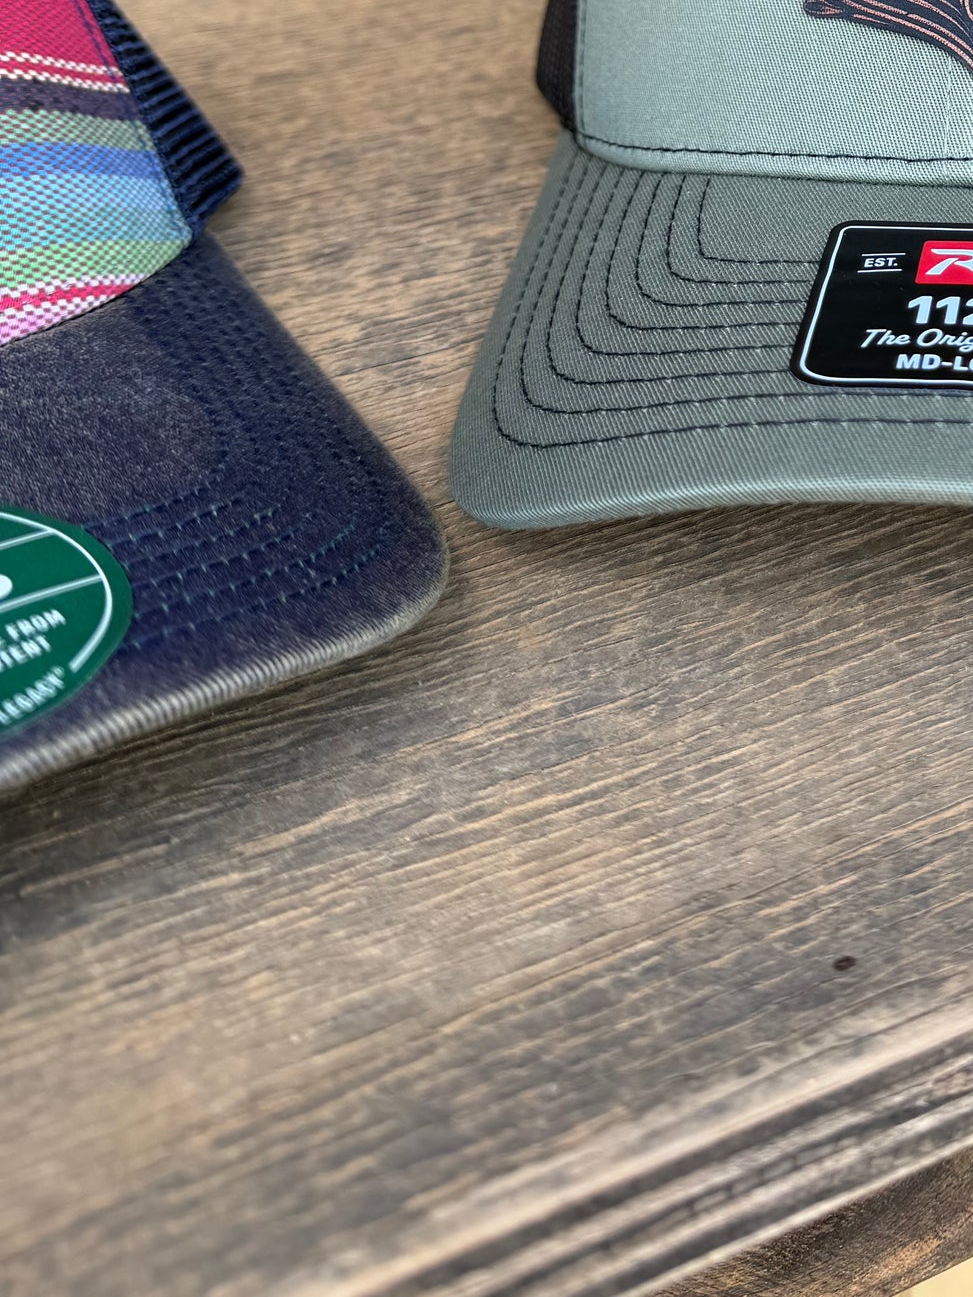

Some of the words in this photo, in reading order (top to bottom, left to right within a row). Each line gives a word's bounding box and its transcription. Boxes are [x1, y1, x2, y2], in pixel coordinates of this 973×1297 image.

[863, 257, 898, 268] EST.
[860, 329, 911, 349] The
[5, 608, 66, 641] FROM
[0, 634, 51, 672] TENT
